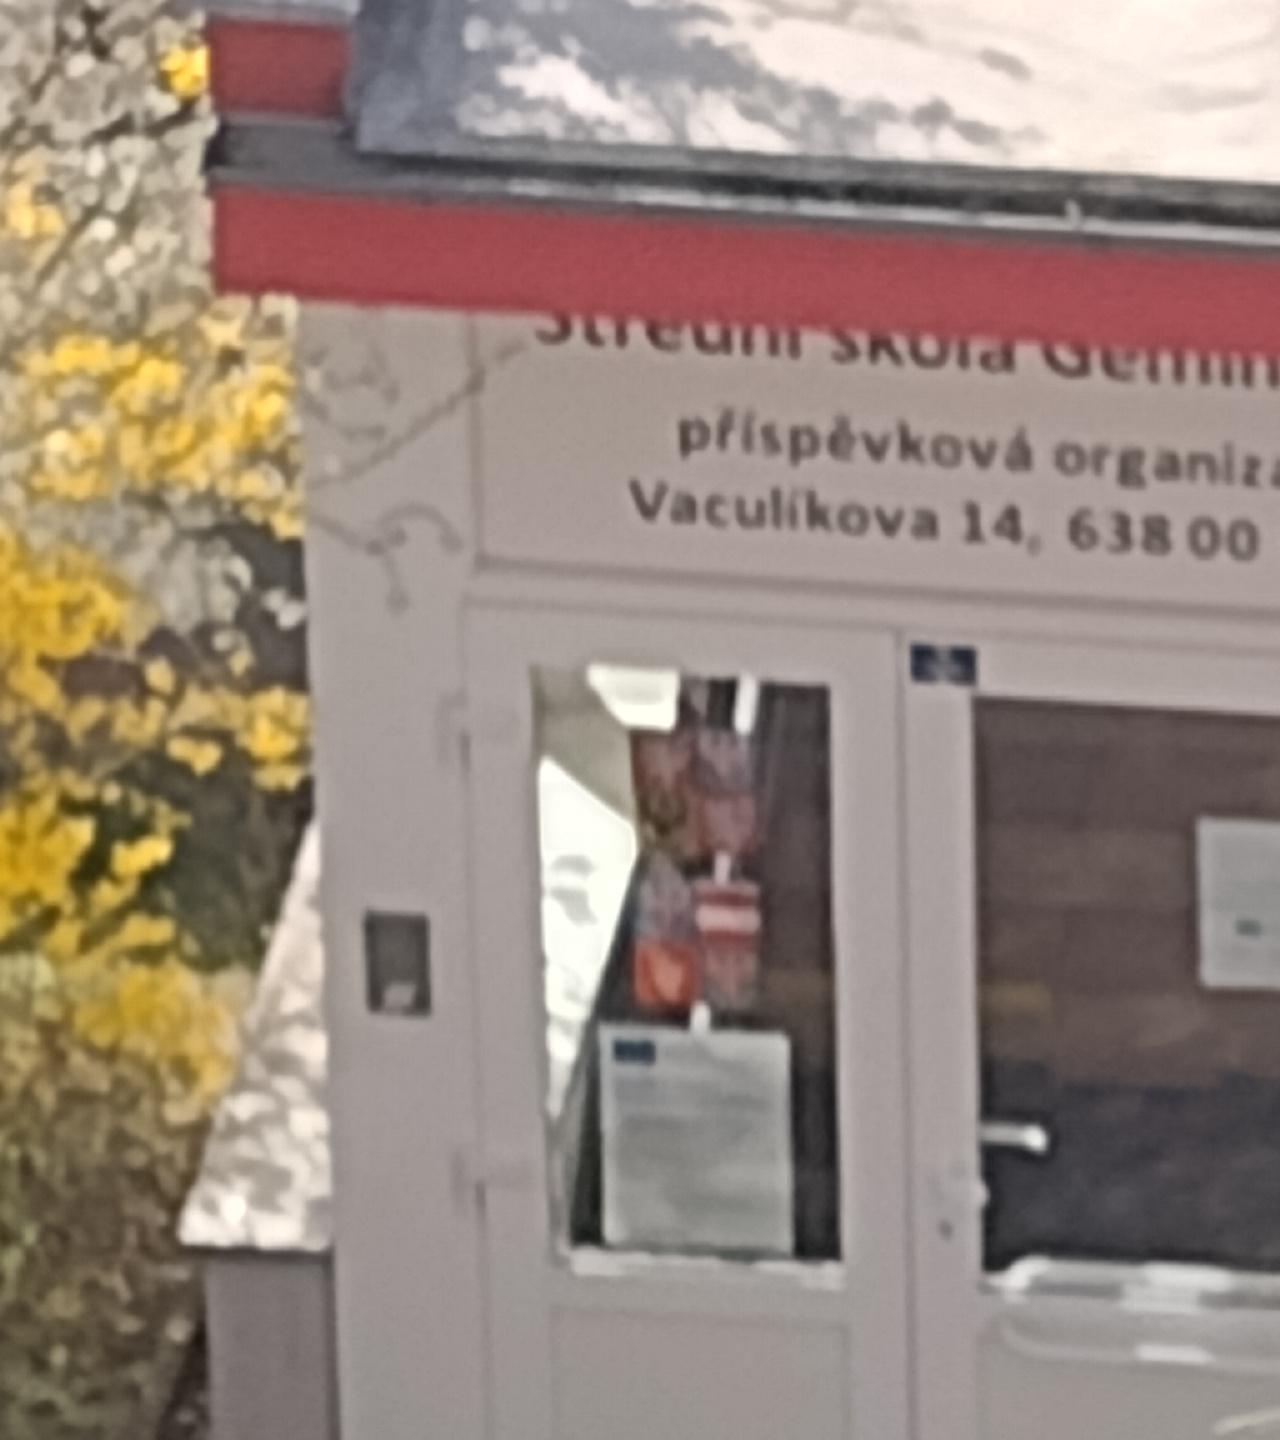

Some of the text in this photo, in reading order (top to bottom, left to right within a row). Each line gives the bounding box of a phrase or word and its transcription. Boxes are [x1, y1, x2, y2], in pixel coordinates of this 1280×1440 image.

[677, 406, 1035, 473] příspěvková
[961, 500, 1043, 557] 14,
[1066, 507, 1174, 557] 638
[1187, 515, 1262, 564] 00
